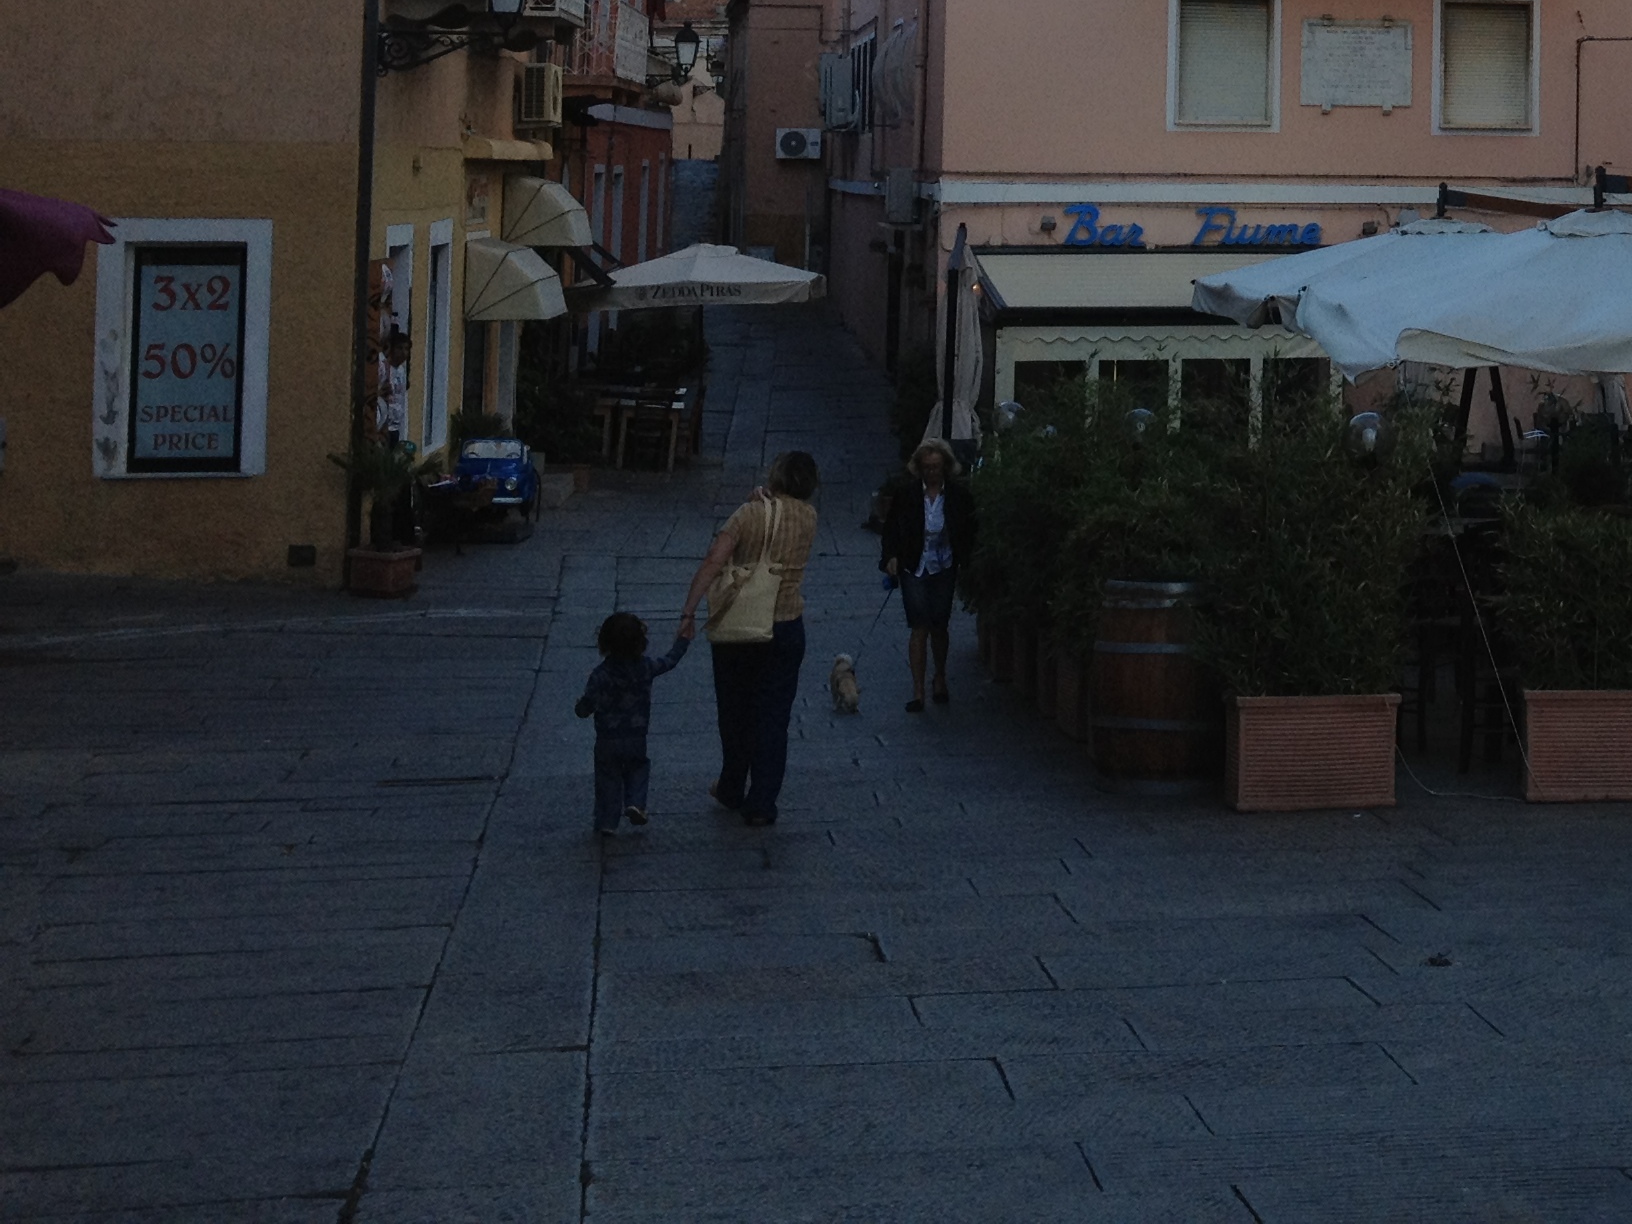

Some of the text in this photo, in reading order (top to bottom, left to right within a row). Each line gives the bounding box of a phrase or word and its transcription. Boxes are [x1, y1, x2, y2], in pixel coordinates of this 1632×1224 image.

[1064, 203, 1144, 247] Bar
[152, 275, 231, 311] 3x2
[142, 343, 235, 380] 50%
[140, 404, 234, 423] SPECIAL
[152, 432, 218, 451] PRICE
